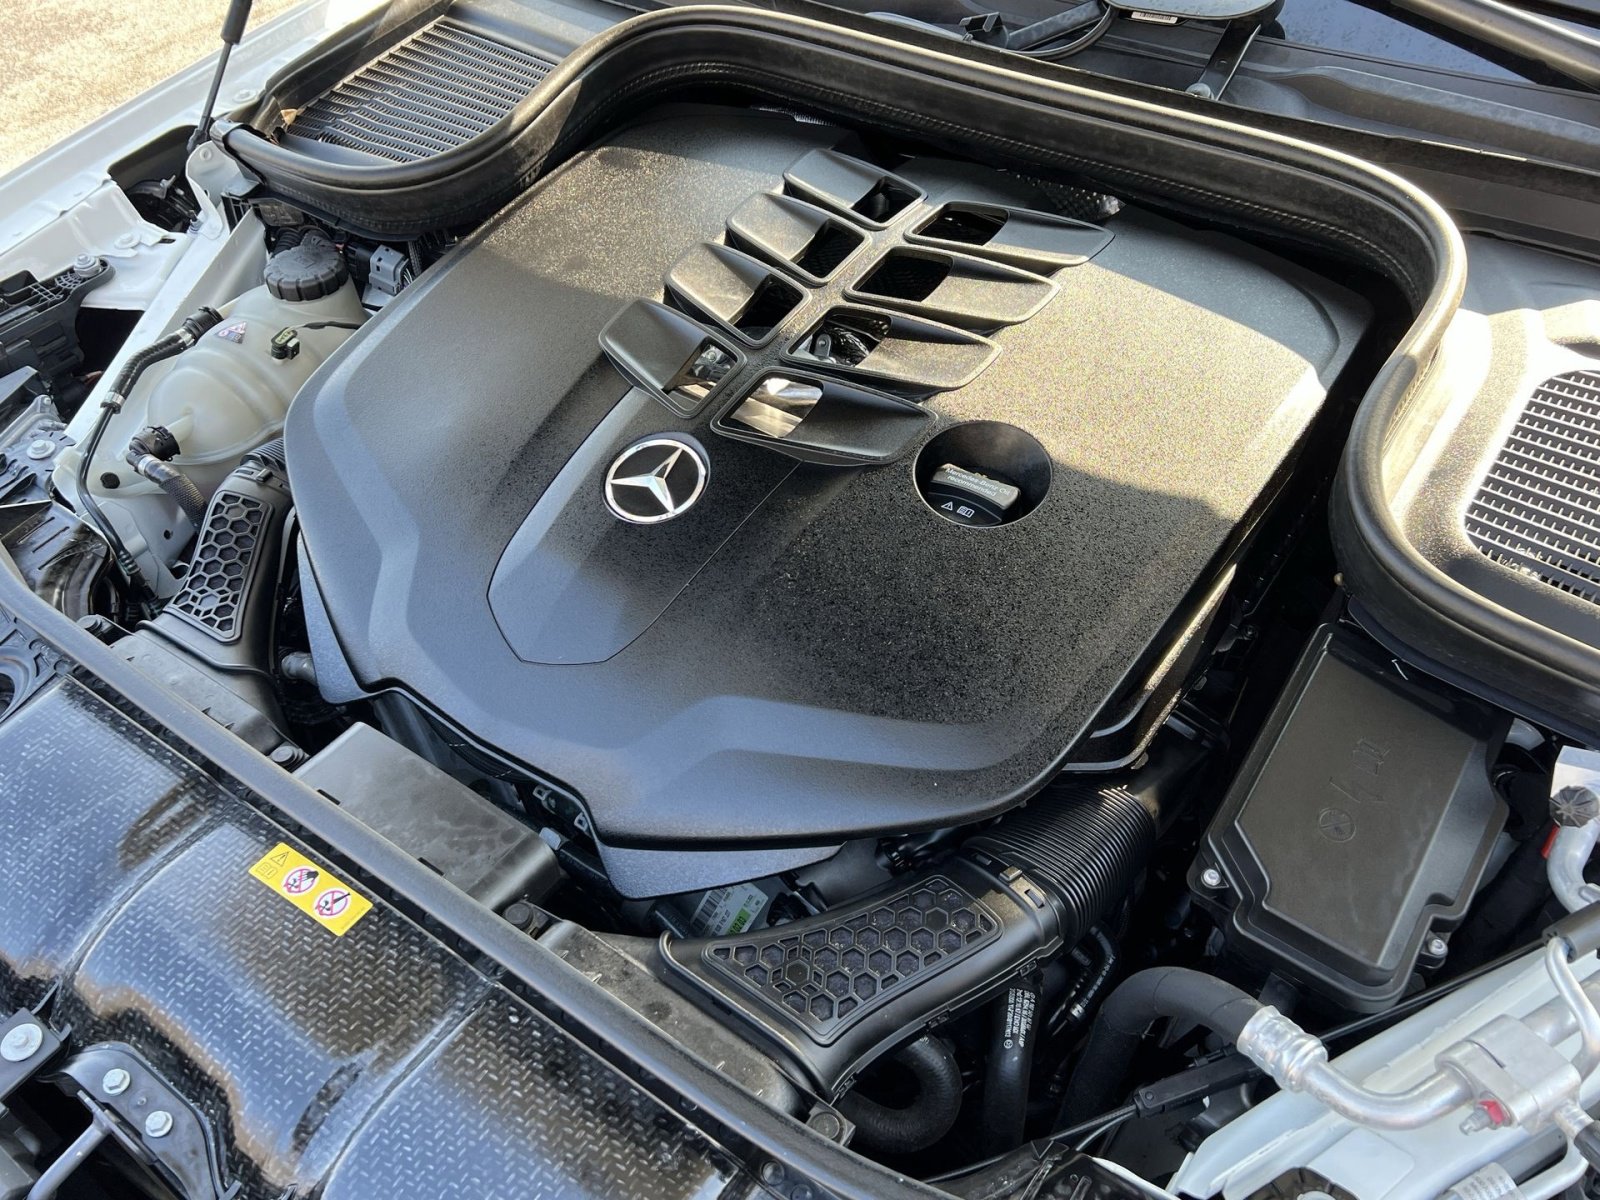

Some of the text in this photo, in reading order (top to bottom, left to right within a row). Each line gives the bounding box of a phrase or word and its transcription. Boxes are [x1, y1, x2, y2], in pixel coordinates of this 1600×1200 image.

[945, 467, 1011, 497] Mercedes-Benz Oil
[946, 474, 997, 497] recommended
